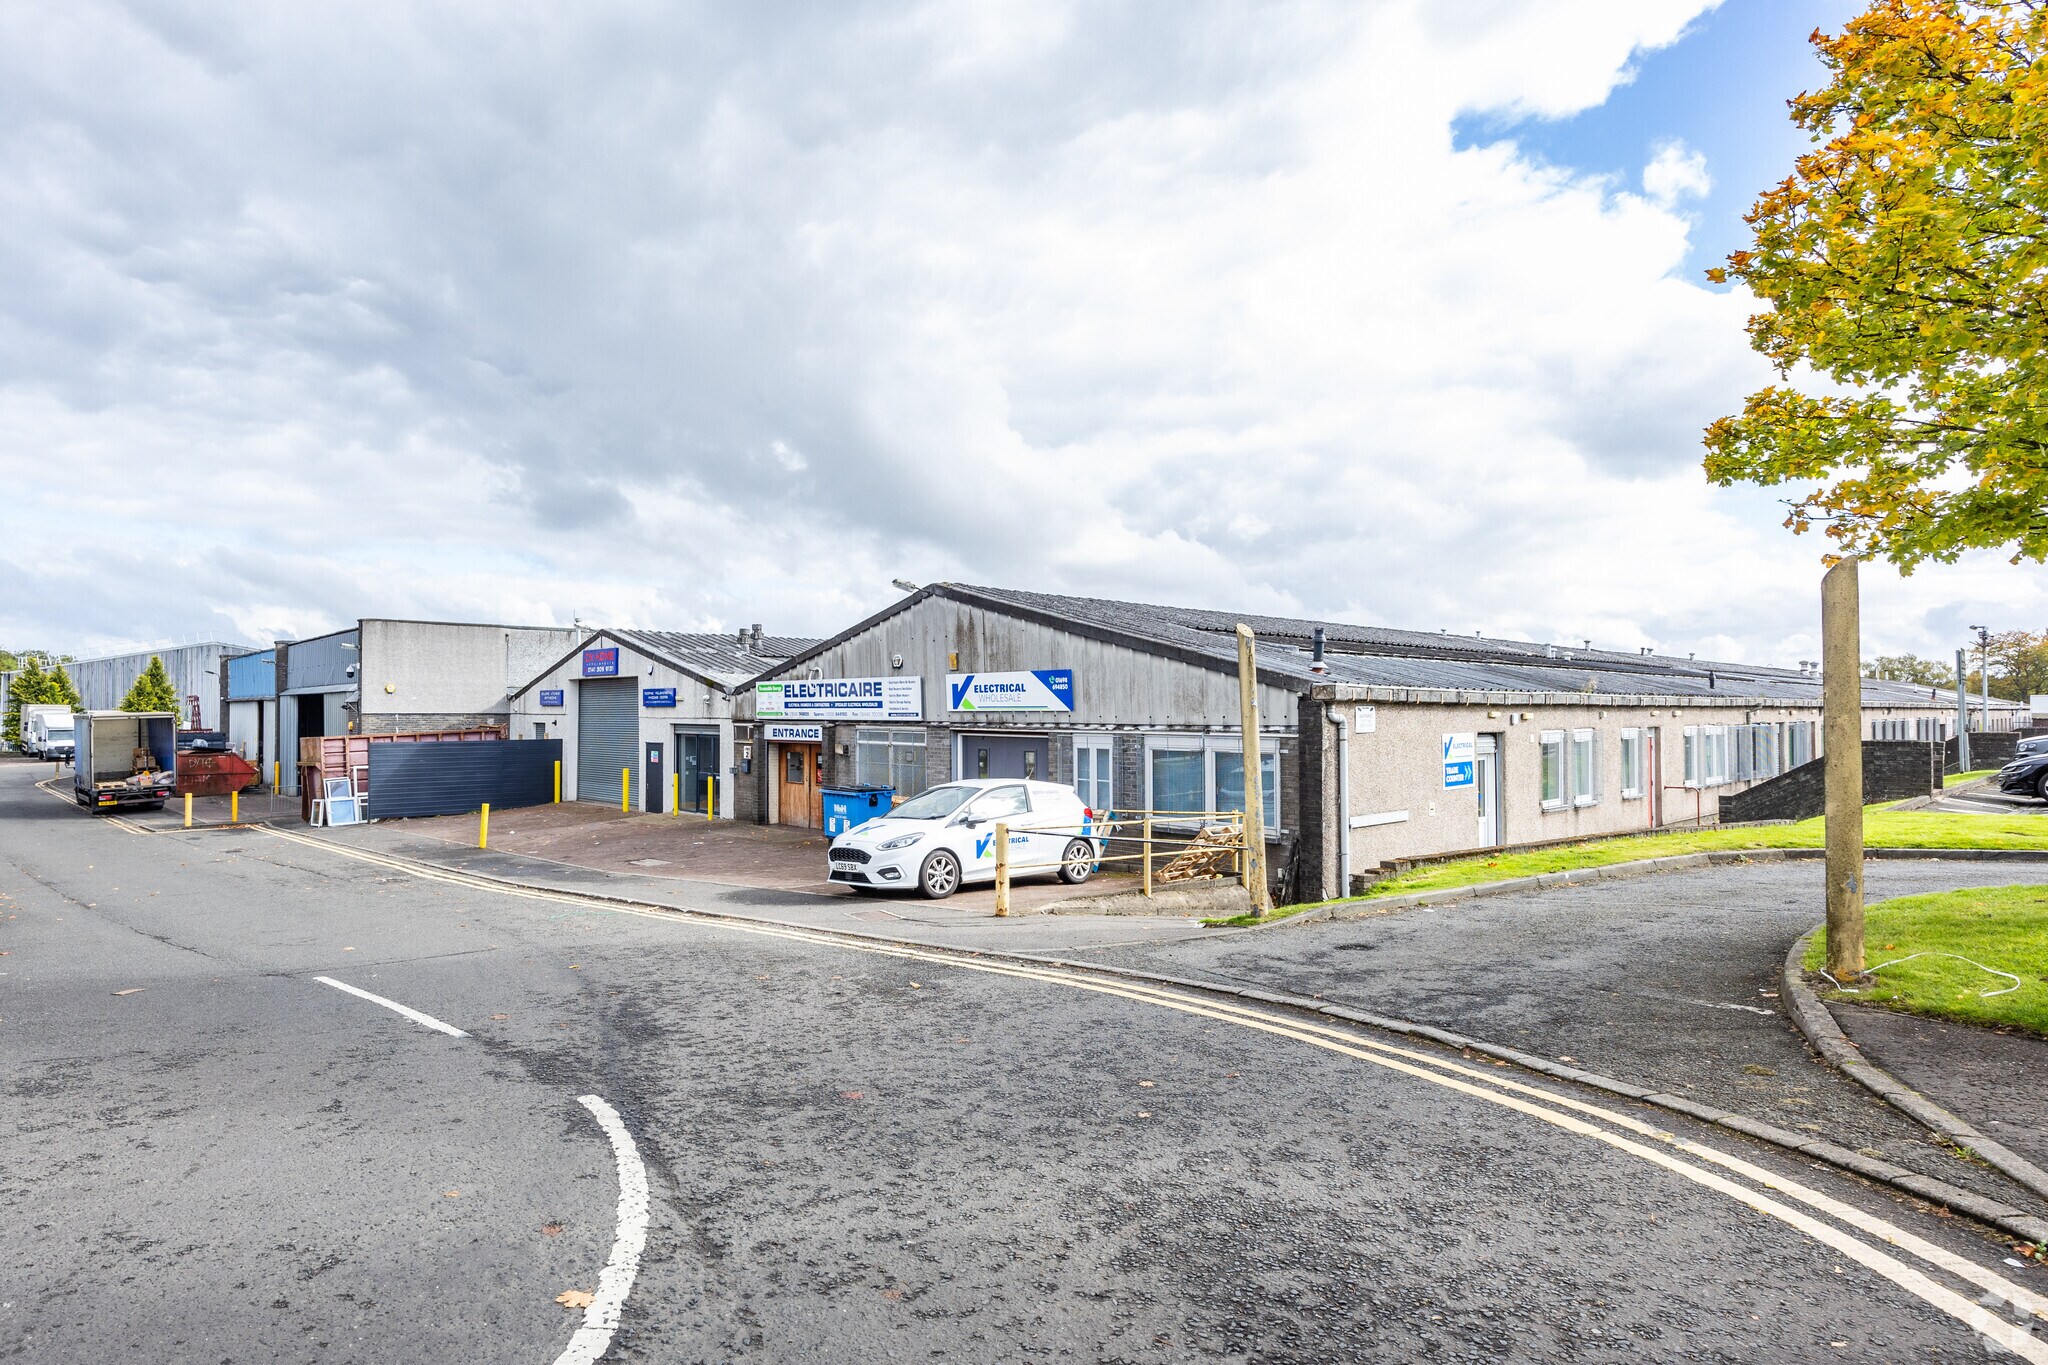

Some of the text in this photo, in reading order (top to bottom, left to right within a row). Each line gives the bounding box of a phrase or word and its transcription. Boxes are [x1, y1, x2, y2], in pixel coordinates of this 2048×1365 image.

[784, 681, 883, 698] ELECTRICAIRE
[974, 683, 1027, 693] ELECTRICAL
[978, 693, 1022, 703] WHOLESALE
[772, 728, 819, 738] ENTRANCE
[993, 836, 1029, 846] ETRICAL
